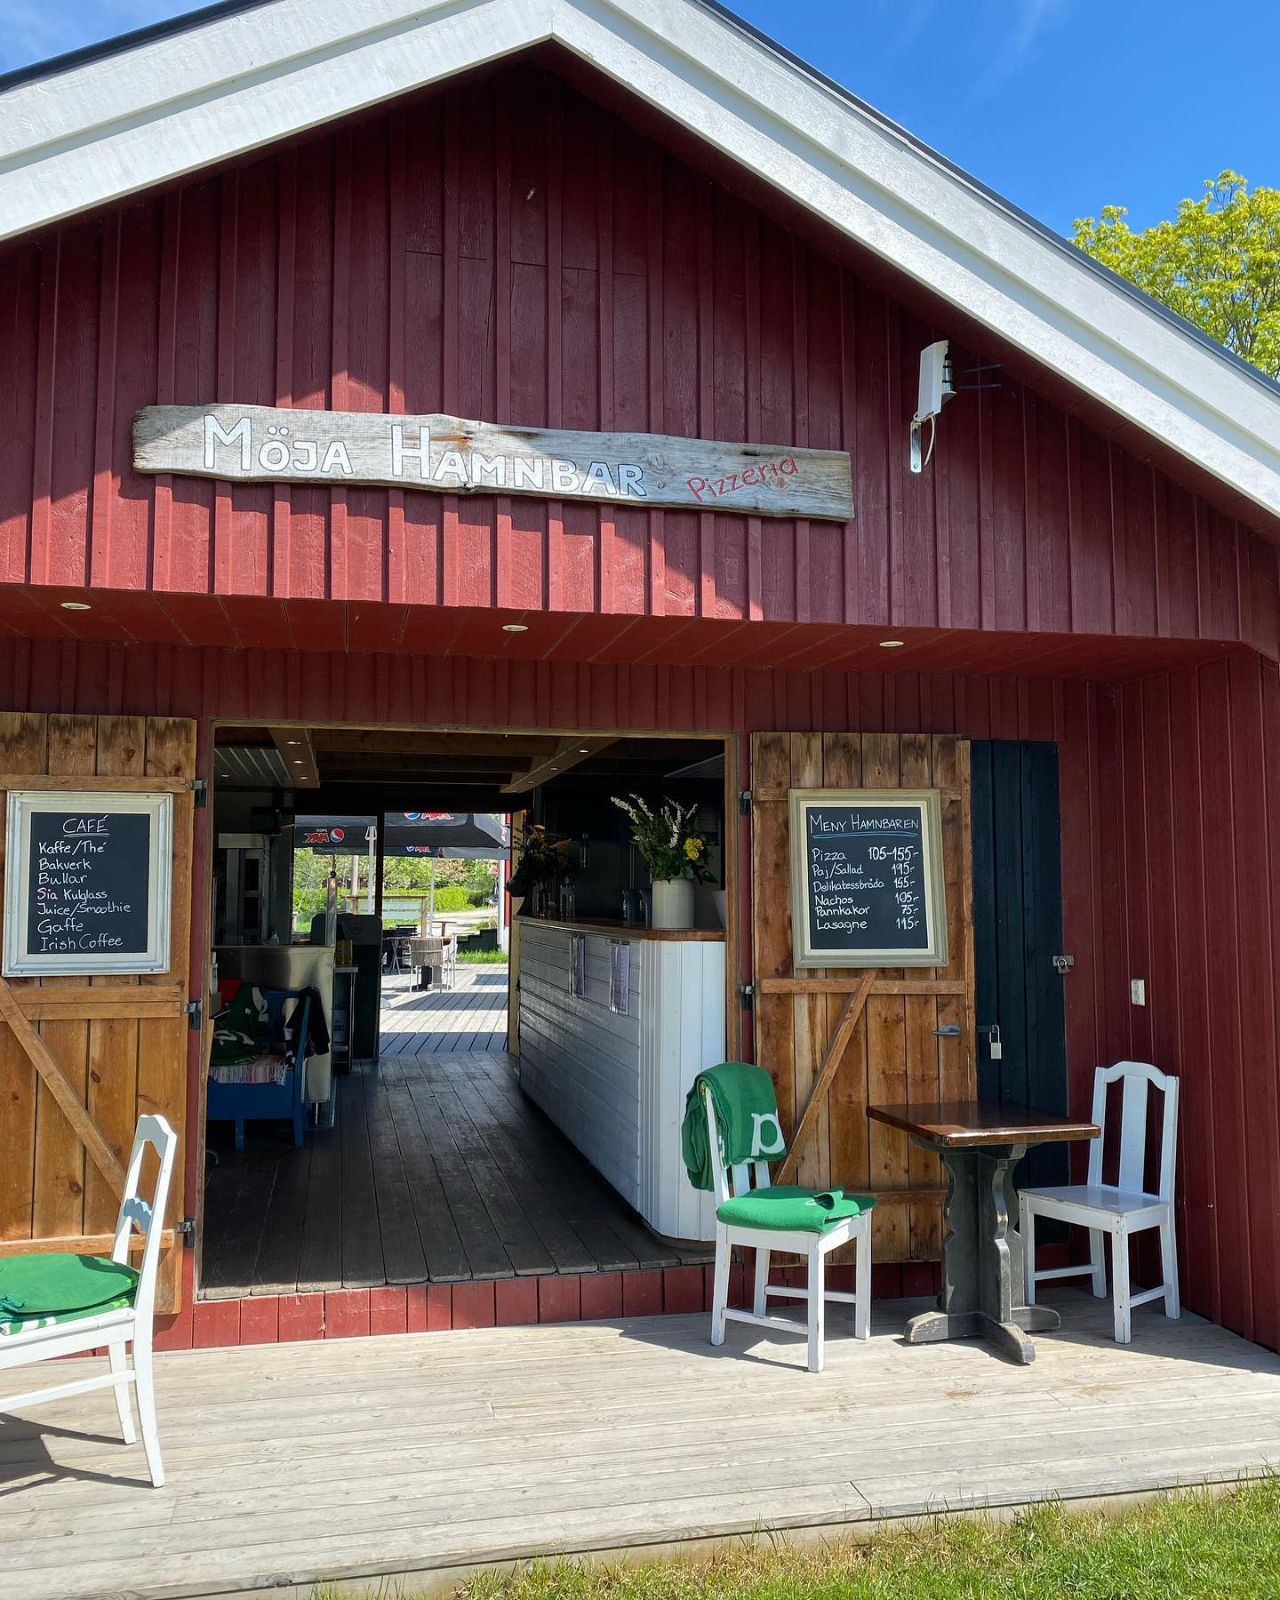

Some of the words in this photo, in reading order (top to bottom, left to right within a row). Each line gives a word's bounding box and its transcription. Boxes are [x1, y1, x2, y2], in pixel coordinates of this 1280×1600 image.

[202, 413, 354, 474] MÖJA
[390, 424, 648, 497] HAMNBAR
[686, 455, 799, 503] Pizzeria
[62, 814, 109, 834] CAFÉ
[810, 813, 847, 834] MENY
[850, 813, 919, 830] HAMNBAREN
[811, 847, 847, 862] Pizza
[38, 857, 92, 872] Bakverk
[38, 872, 88, 885] Bullar
[37, 887, 58, 900] Sia
[814, 894, 854, 906] Nachos
[814, 904, 870, 917] Pannkakor
[816, 918, 868, 934] Lasagne
[40, 936, 76, 952] Irish
[78, 932, 124, 950] Coffee
